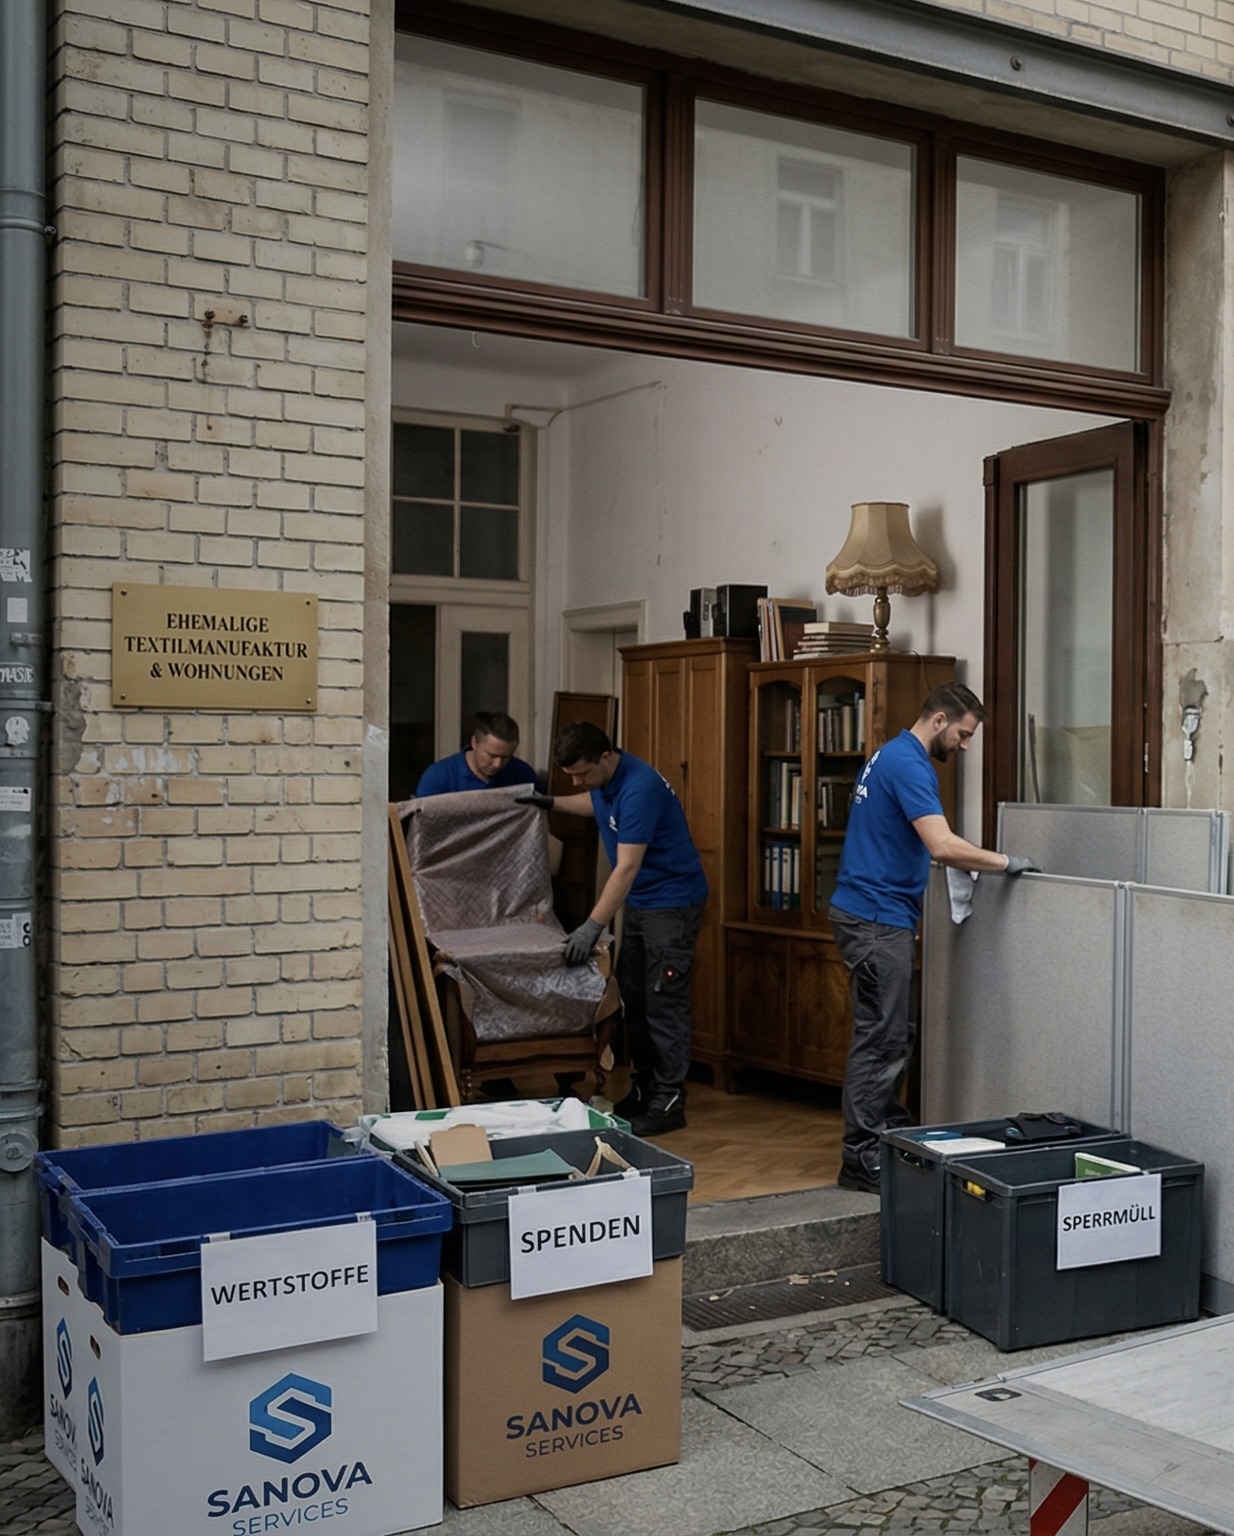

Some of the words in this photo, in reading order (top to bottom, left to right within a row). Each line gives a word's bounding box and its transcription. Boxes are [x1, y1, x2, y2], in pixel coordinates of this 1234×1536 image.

[166, 613, 269, 633] EHEMALIGE
[124, 636, 308, 658] TEXTILMANUFAKTUR
[150, 663, 163, 679] &
[168, 662, 284, 682] WOHNUNGEN
[521, 1215, 640, 1253] SPENDEN
[1063, 1203, 1155, 1231] SPERRMÜLL
[211, 1264, 369, 1305] WERTSTOFFE
[506, 1393, 642, 1440] SANOVA
[525, 1425, 623, 1458] SERVICES
[207, 1461, 373, 1517] SANOVA
[232, 1497, 348, 1536] SERVICES
